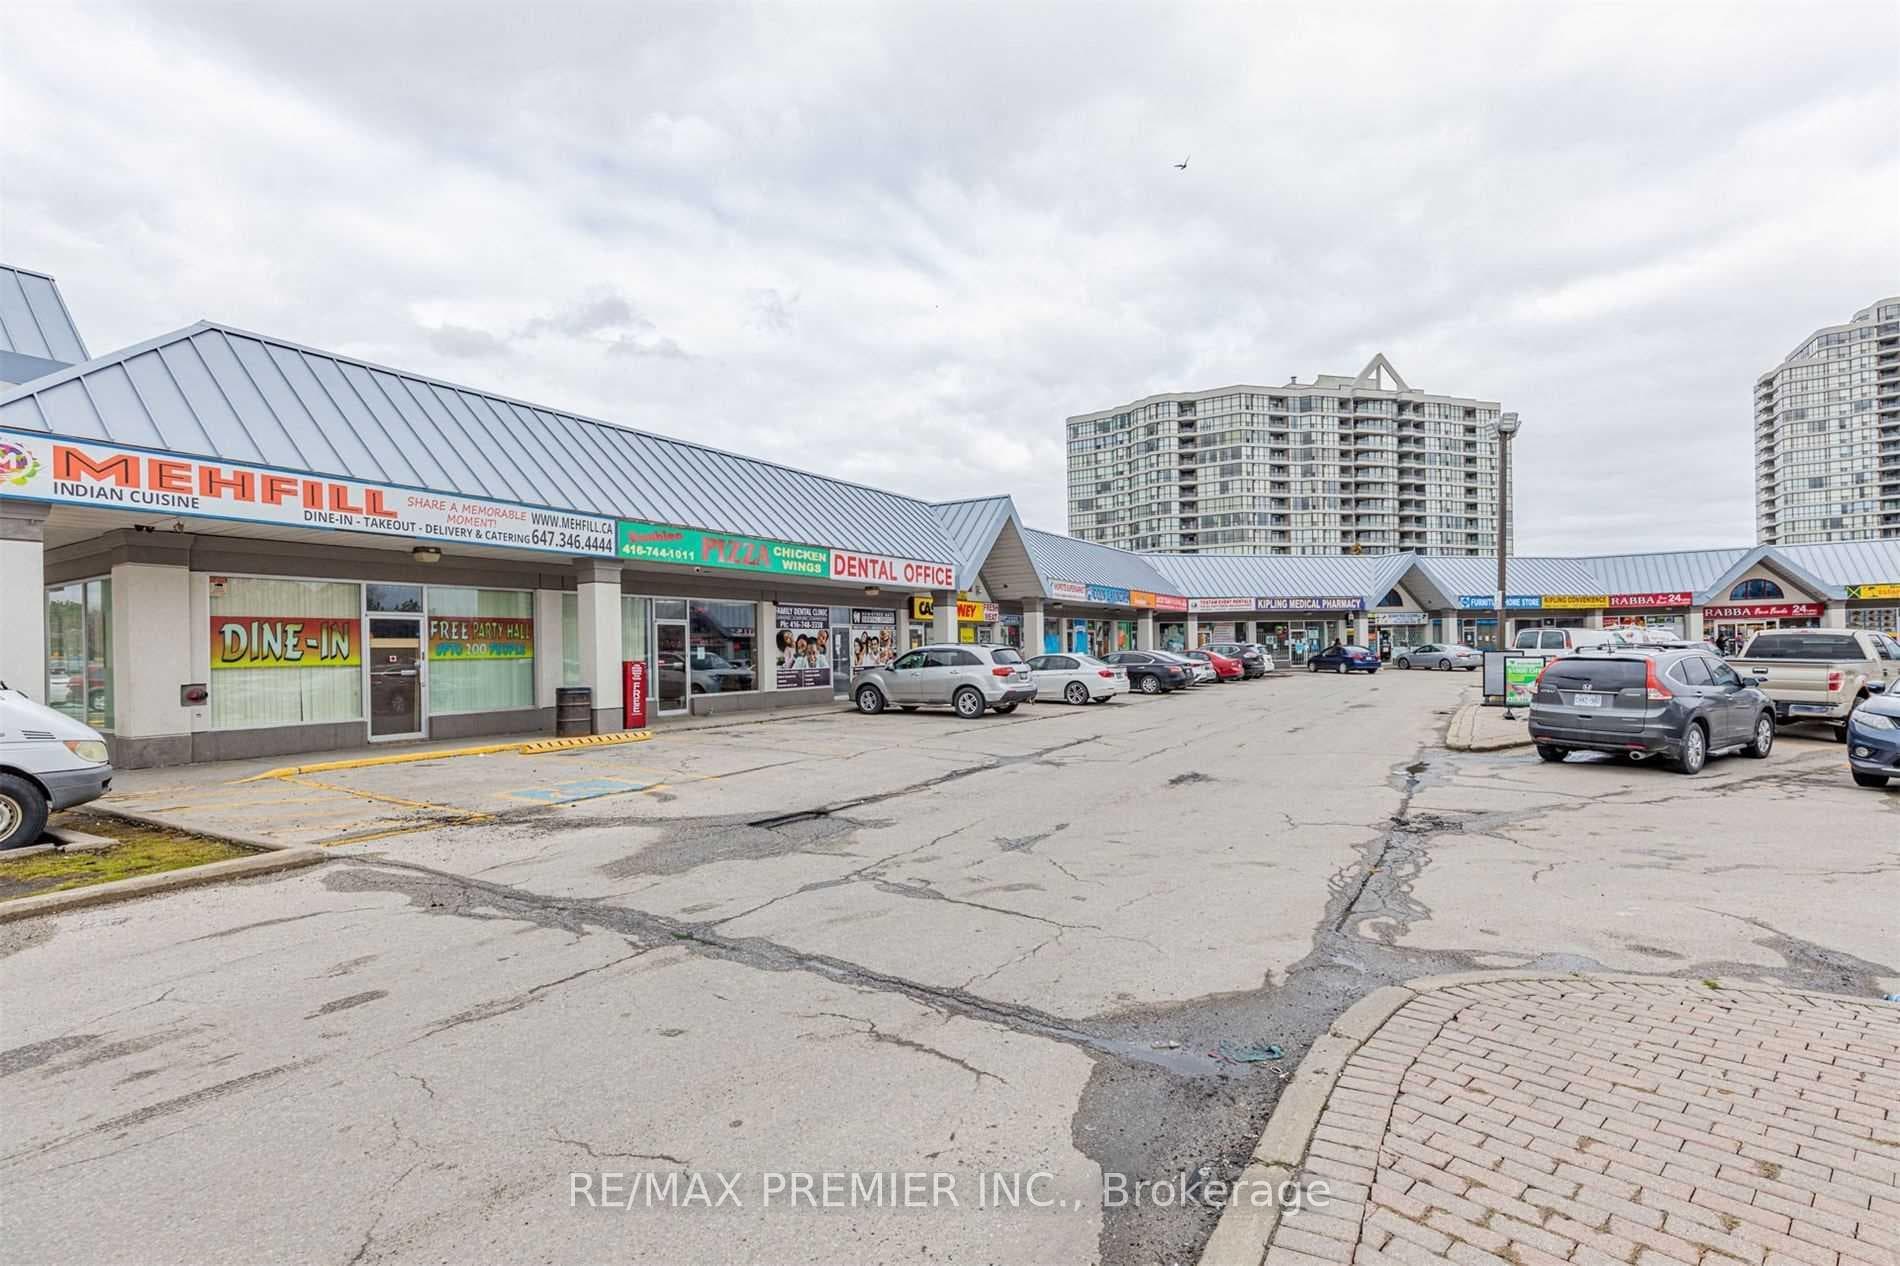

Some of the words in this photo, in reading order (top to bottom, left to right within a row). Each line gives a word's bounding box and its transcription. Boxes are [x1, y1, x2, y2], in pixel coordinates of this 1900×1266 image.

[53, 445, 397, 518] MEHFILL
[54, 482, 123, 501] INDIAN
[131, 490, 199, 509] CUISINE
[407, 497, 446, 511] SHARE
[449, 503, 458, 512] A
[462, 504, 527, 521] MEMORABLE
[304, 510, 352, 525] DINE-IN
[364, 517, 416, 532] TAKEOUT
[425, 524, 472, 539] DELIVERY
[476, 530, 482, 538] &
[485, 530, 530, 544] CATERING
[447, 515, 496, 528] MOMENT!
[531, 512, 612, 535] WWW.MEHFILL.CA
[531, 529, 612, 552] 647.346.4444
[702, 537, 772, 567] PIZZA
[773, 546, 826, 562] CHICKEN
[782, 560, 821, 573] WINGS
[834, 554, 898, 581] DENTAL
[904, 563, 953, 586] OFFICE
[1258, 599, 1288, 609] KIPLING
[1289, 599, 1320, 609] MEDICAL
[1322, 599, 1360, 609] PHARMACY
[1611, 597, 1655, 605] RABBA
[1667, 594, 1681, 602] 24
[1705, 608, 1751, 617] RABBA
[1792, 605, 1806, 613] 24
[219, 621, 349, 662] DINE-IN
[430, 620, 468, 640] FREE
[473, 622, 503, 639] PARTY
[507, 623, 529, 639] HALL
